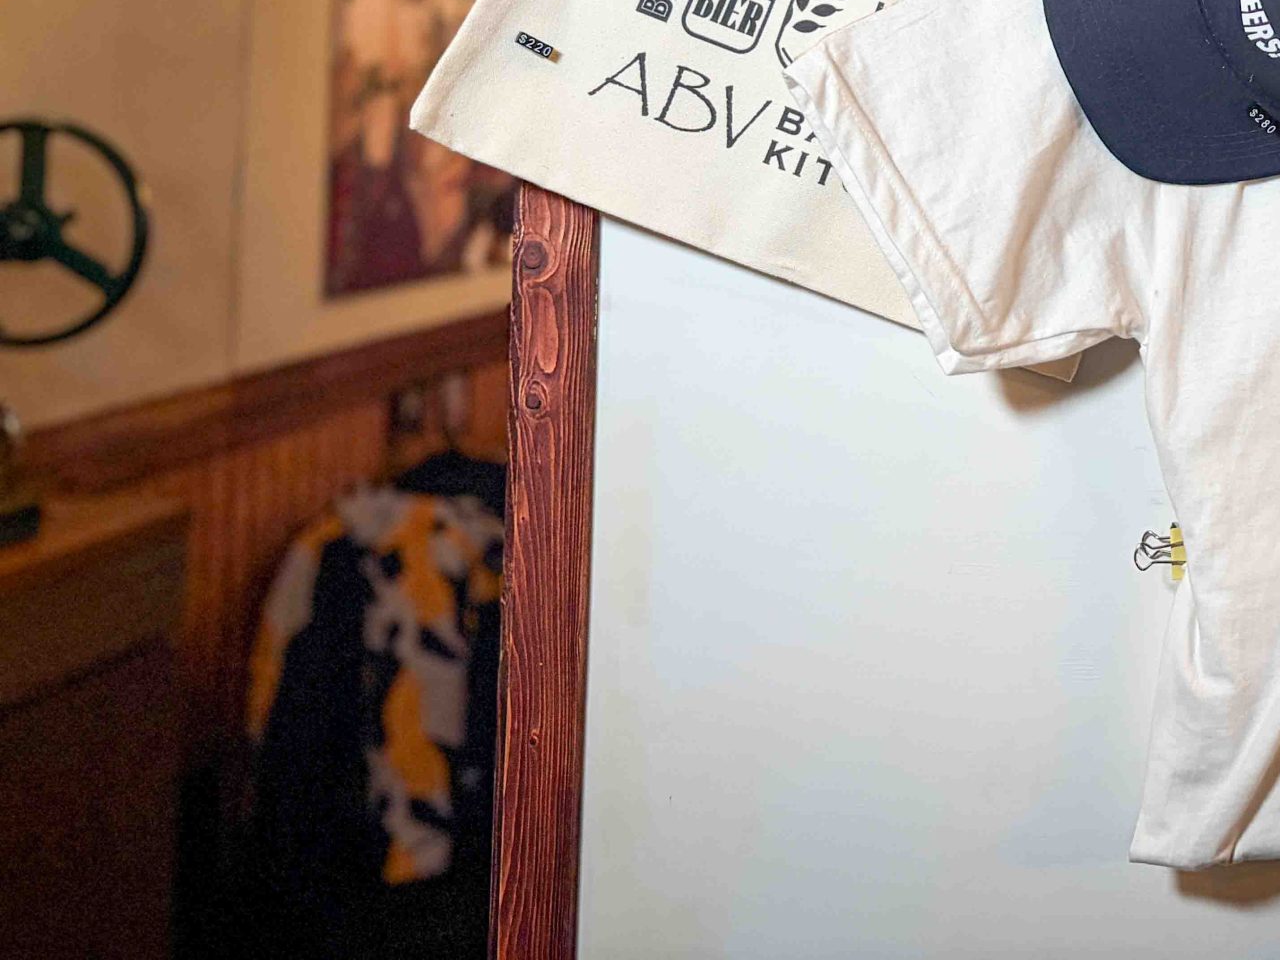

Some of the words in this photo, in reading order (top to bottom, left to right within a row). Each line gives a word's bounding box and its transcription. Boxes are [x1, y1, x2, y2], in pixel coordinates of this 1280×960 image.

[519, 34, 552, 57] $220
[588, 52, 772, 149] ABV
[1249, 108, 1277, 134] $280
